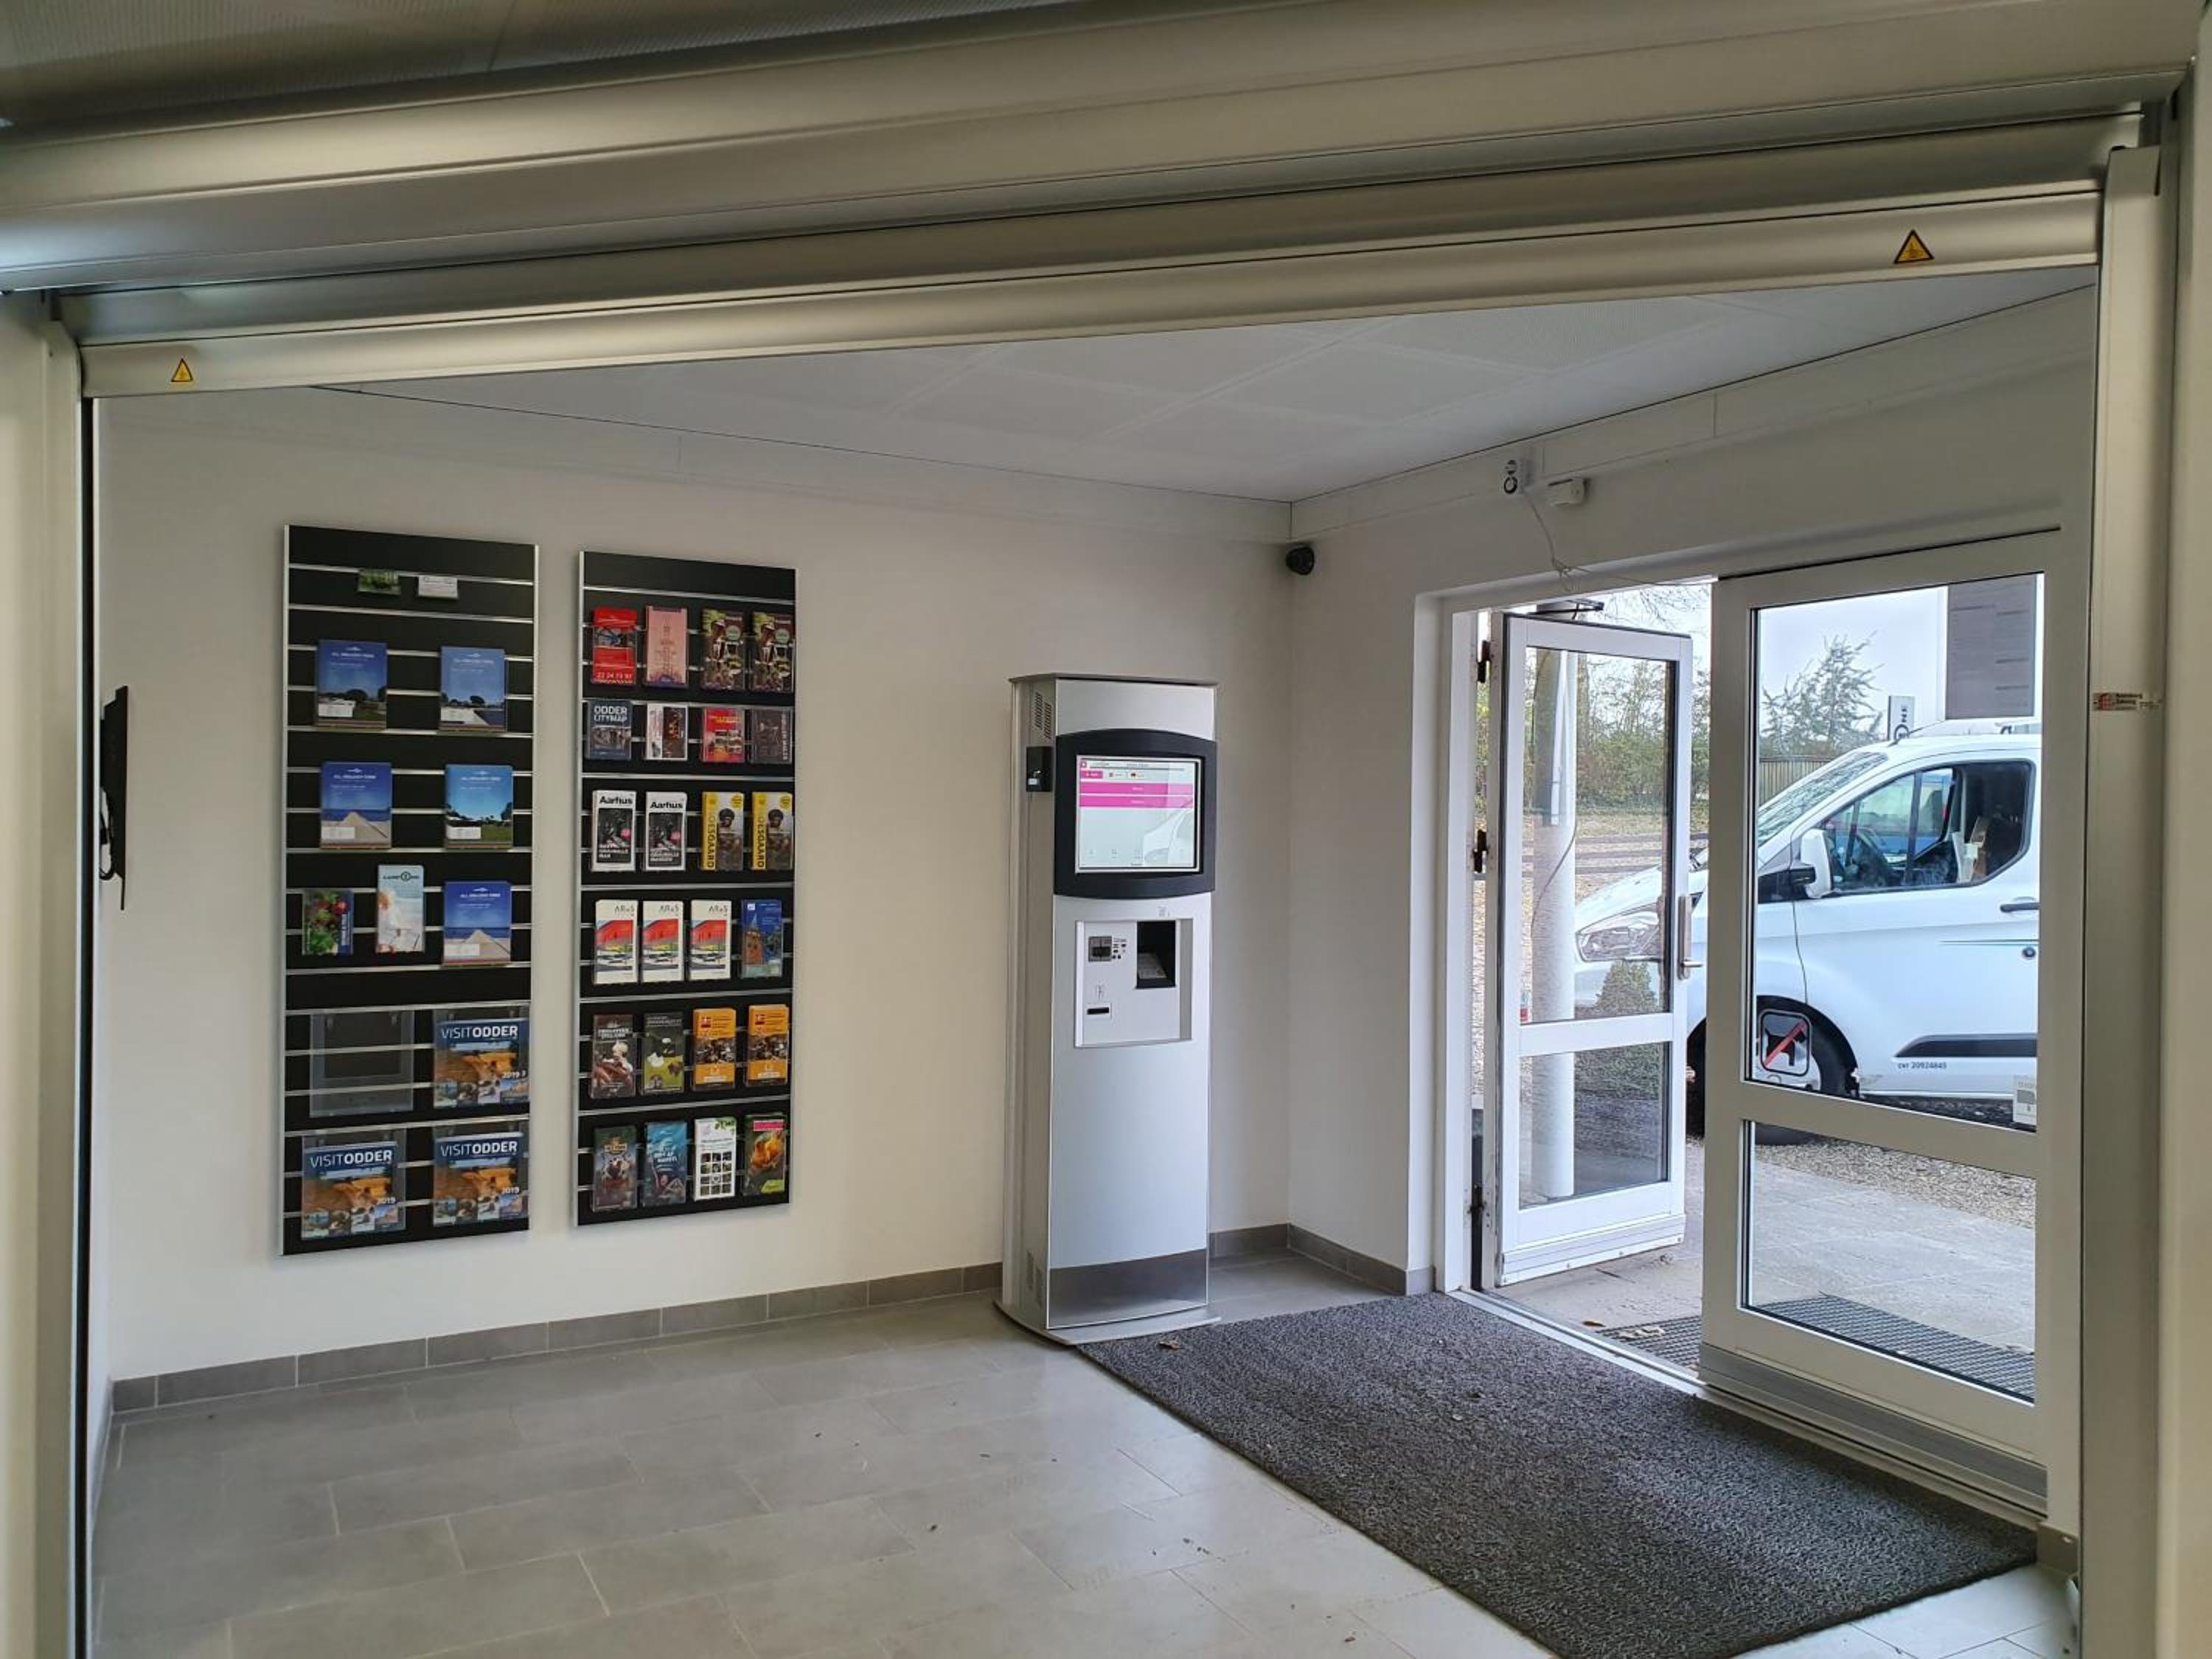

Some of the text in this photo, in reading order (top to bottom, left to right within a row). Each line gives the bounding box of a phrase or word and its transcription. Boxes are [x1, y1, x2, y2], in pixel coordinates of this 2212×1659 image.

[594, 705, 627, 714] ODDER
[599, 796, 633, 804] Aarhus
[706, 808, 716, 868] OESGAARD
